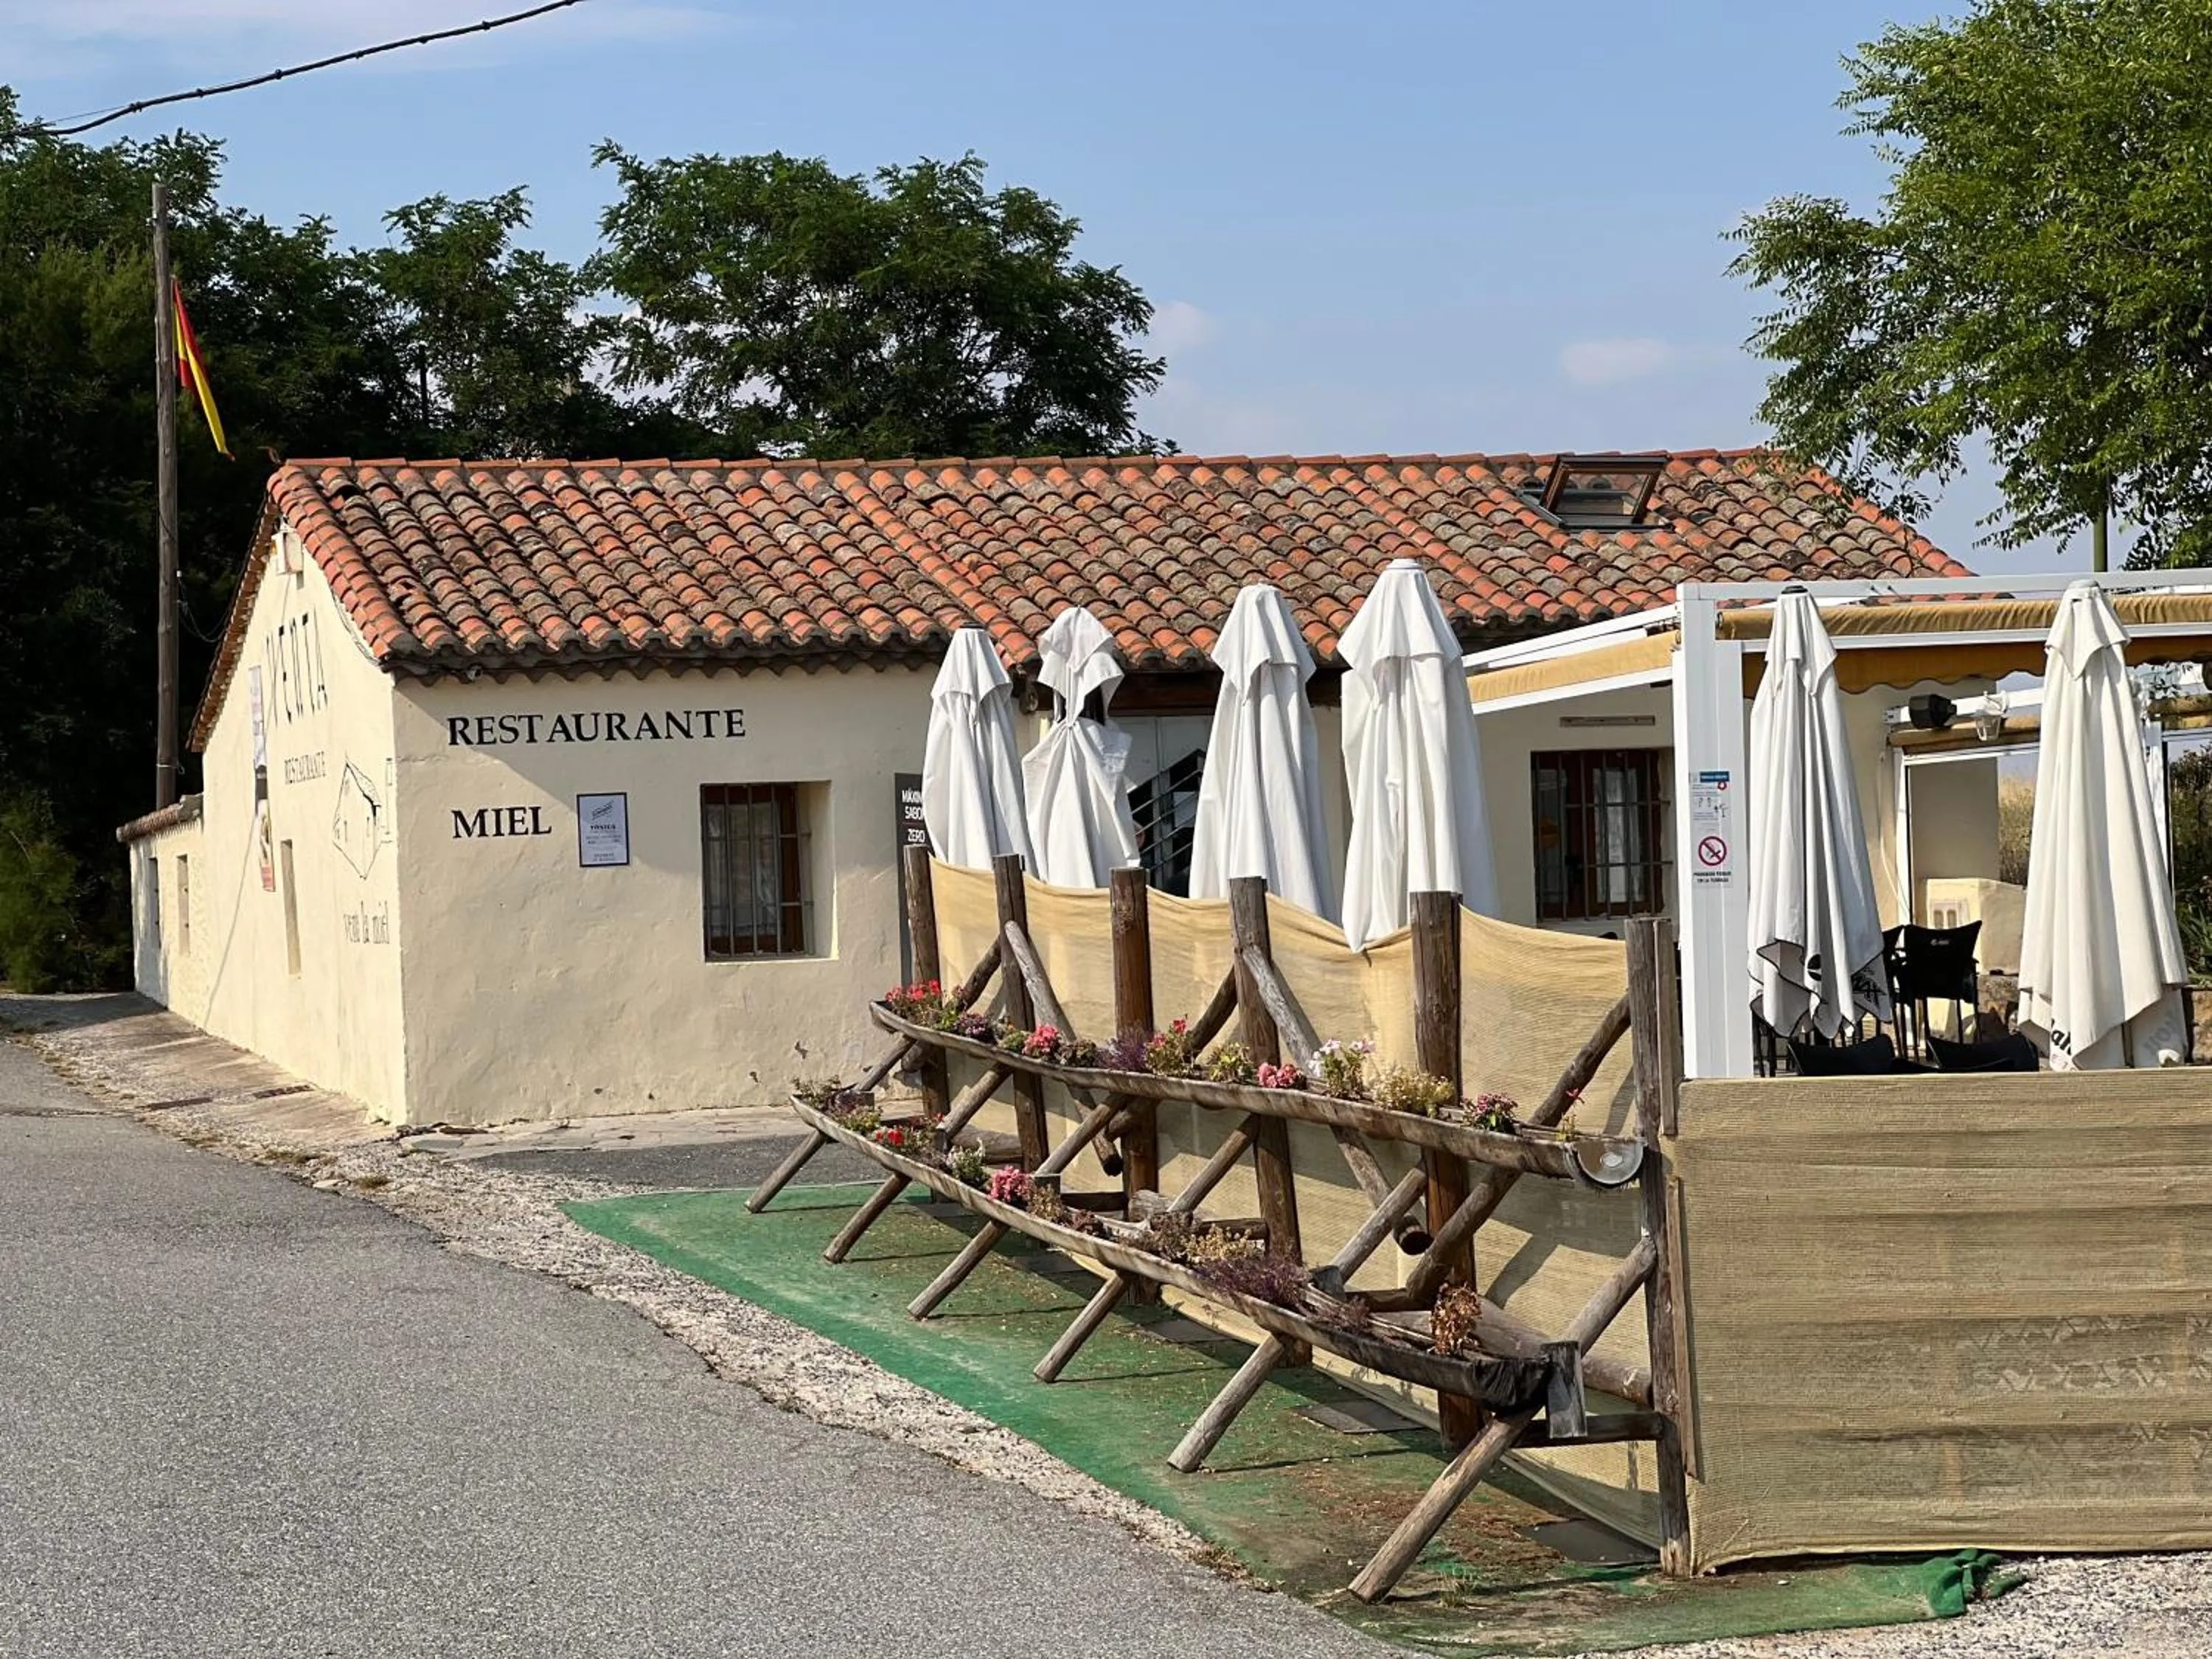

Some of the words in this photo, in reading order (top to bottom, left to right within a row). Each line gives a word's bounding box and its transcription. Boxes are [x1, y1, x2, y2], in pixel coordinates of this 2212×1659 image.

[265, 603, 329, 727] VENTA
[448, 709, 745, 745] RESTAURANTE
[284, 751, 326, 785] RESTAURANTE
[451, 806, 552, 839] MIEL
[905, 806, 923, 820] SABO
[908, 828, 925, 842] ZERO
